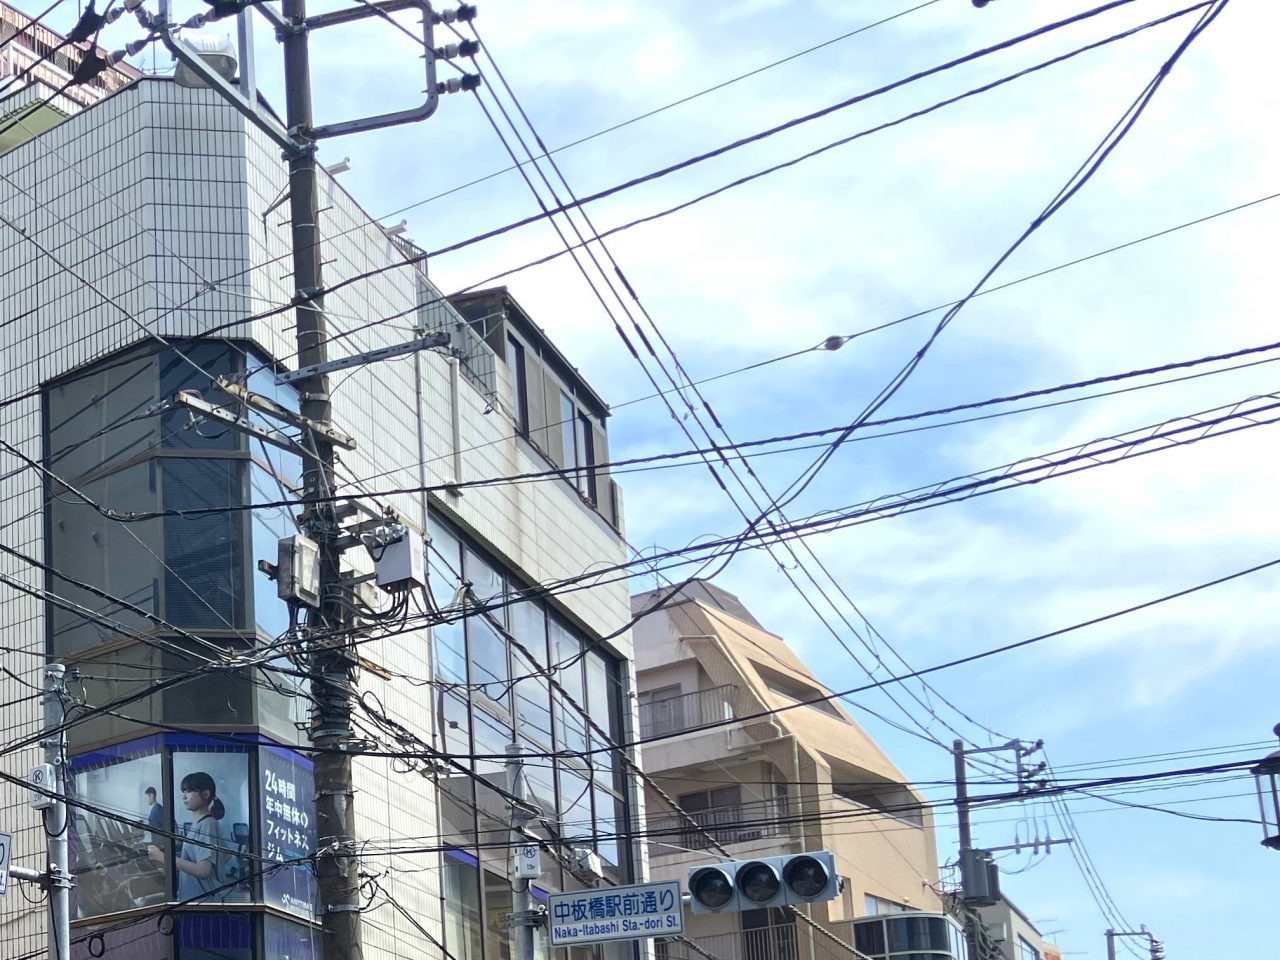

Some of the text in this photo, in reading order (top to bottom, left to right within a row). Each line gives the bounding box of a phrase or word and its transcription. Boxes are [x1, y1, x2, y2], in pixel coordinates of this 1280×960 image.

[265, 769, 296, 802] 24時間
[267, 820, 310, 850] フィットネス
[267, 842, 284, 862] ジム
[554, 889, 675, 923] 中板橋駅前通り
[554, 915, 679, 939] Naka-Itabashi Sta.-dori St.
